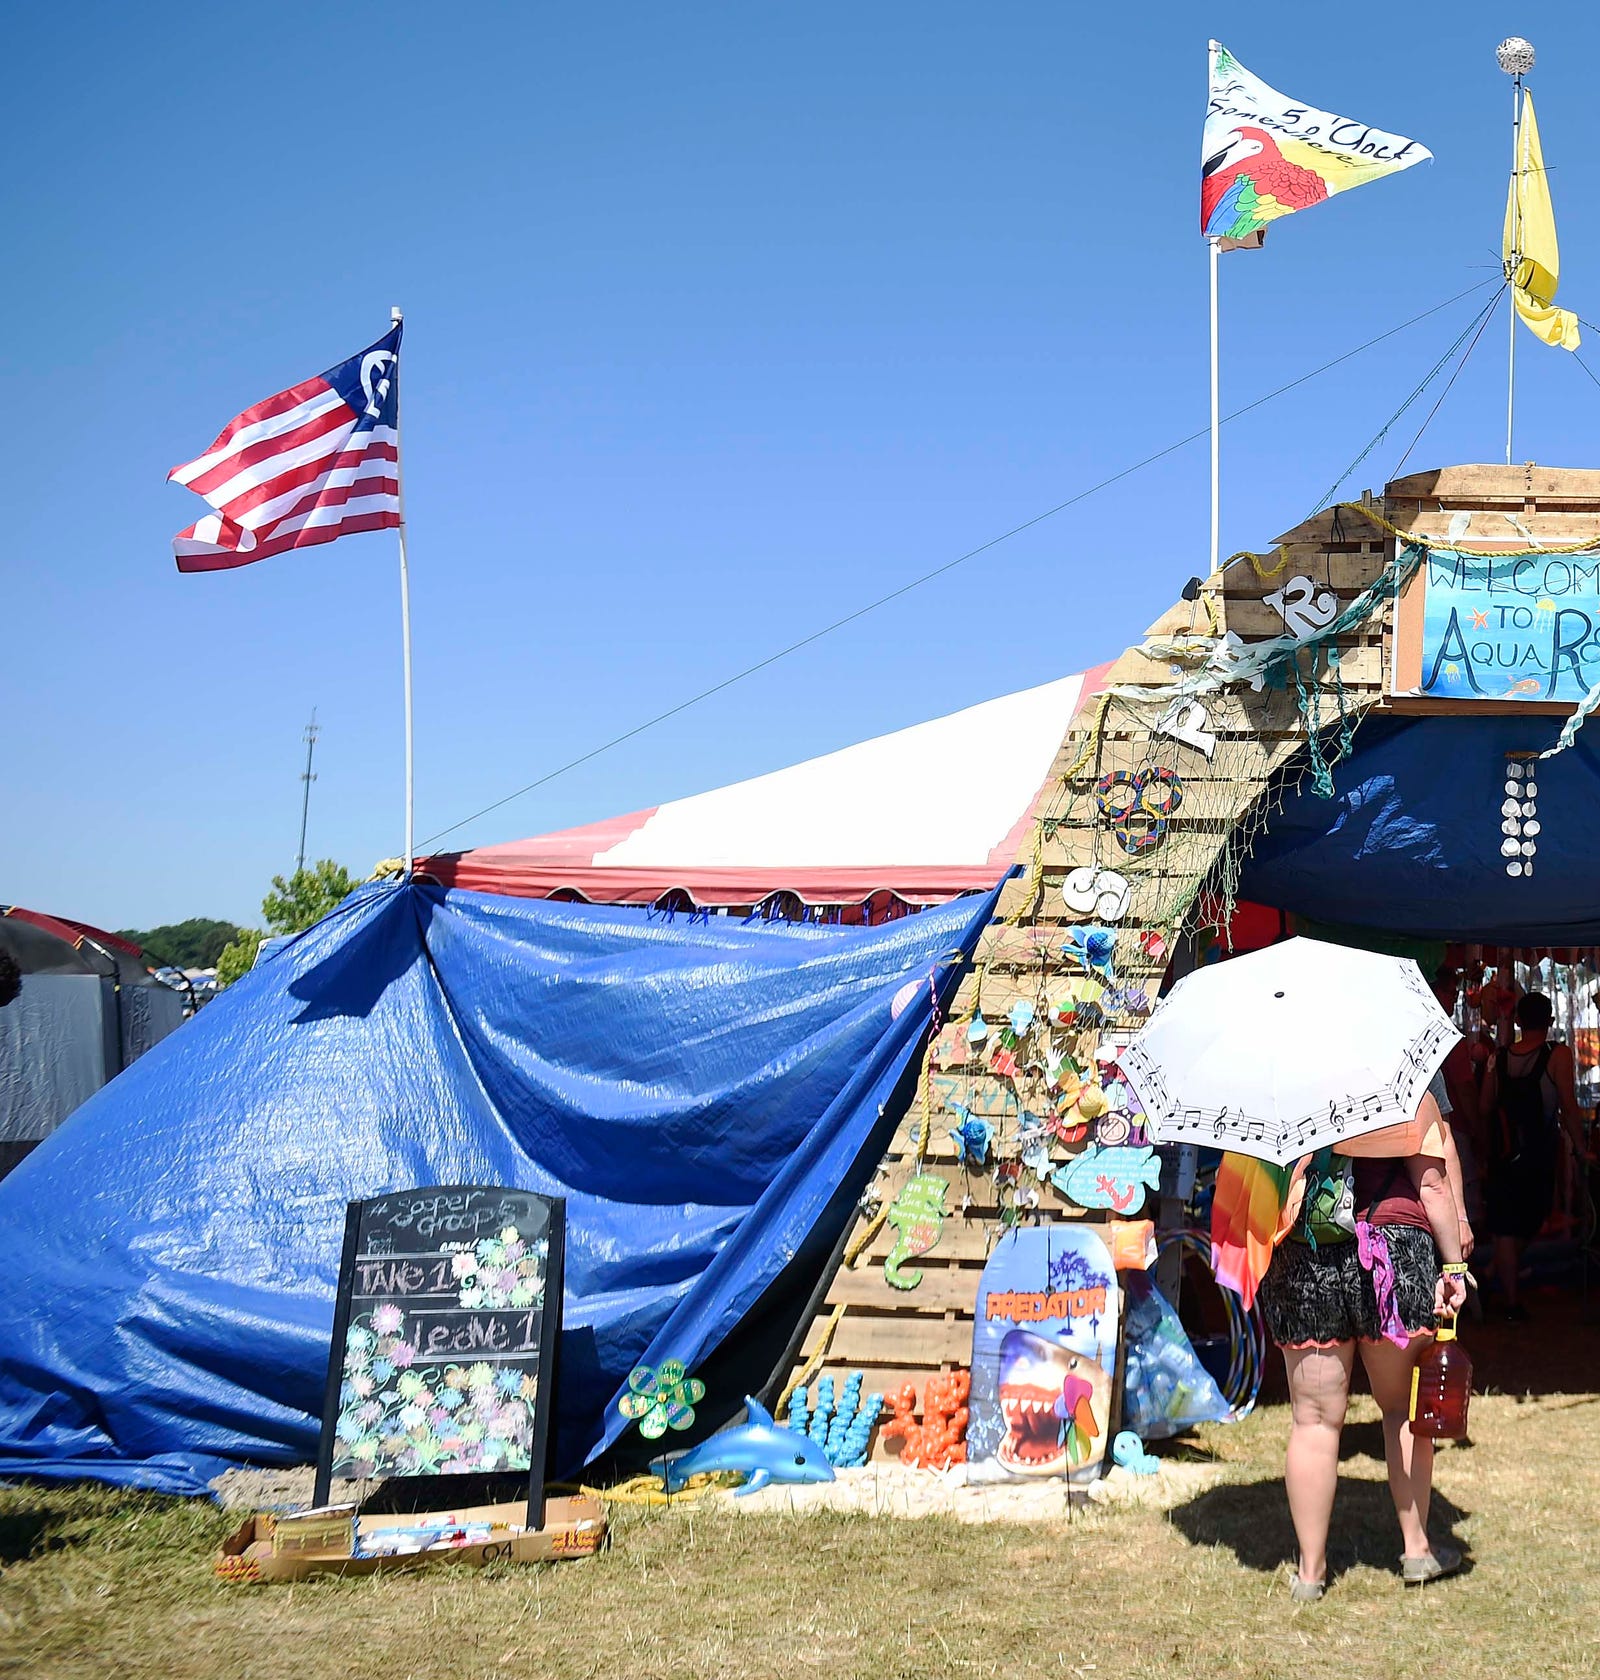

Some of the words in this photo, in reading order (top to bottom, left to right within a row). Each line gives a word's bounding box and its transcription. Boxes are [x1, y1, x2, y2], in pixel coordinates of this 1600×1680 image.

[1282, 109, 1308, 124] 5
[1493, 604, 1533, 628] TO
[427, 1260, 453, 1292] 1
[985, 1285, 1106, 1322] PREDATOR
[514, 1310, 537, 1352] 1
